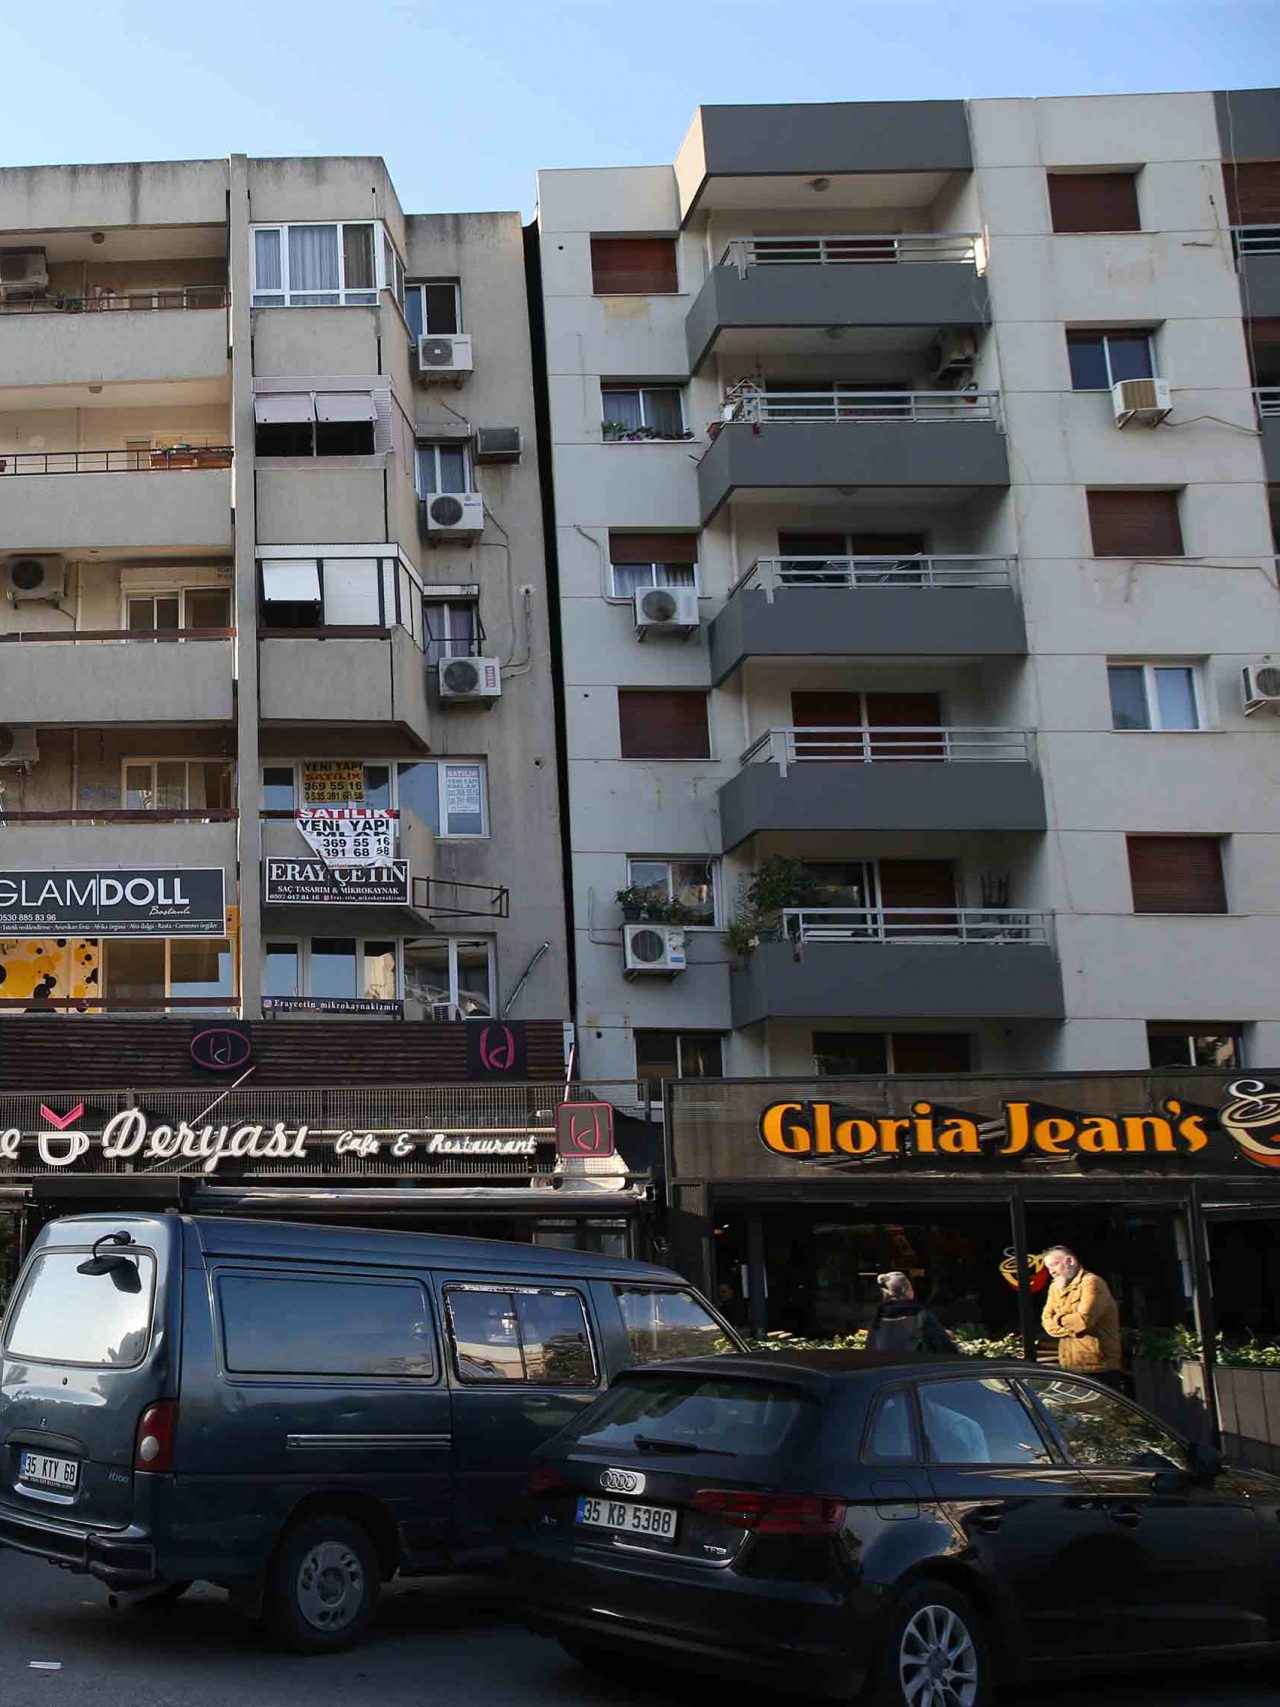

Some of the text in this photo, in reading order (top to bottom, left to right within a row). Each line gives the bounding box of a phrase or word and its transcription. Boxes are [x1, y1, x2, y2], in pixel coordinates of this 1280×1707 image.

[337, 761, 363, 771] YAPI
[305, 772, 361, 781] SATILIK
[304, 781, 363, 790] 369 55 16
[299, 808, 390, 818] SATILIK
[349, 820, 390, 831] YAPI
[323, 837, 390, 847] 369 55 16
[326, 846, 390, 857] 391 68 58
[270, 863, 326, 881] ERAY
[278, 885, 293, 894] SAÇ
[762, 1100, 1209, 1155] Gloria Jean's
[102, 1107, 308, 1173] Deryası
[335, 1130, 379, 1158] Cafe
[391, 1132, 415, 1157] &
[427, 1134, 538, 1155] Restaurant
[25, 1456, 76, 1482] 35 KTY 68
[584, 1500, 671, 1534] 35 KB 5388
